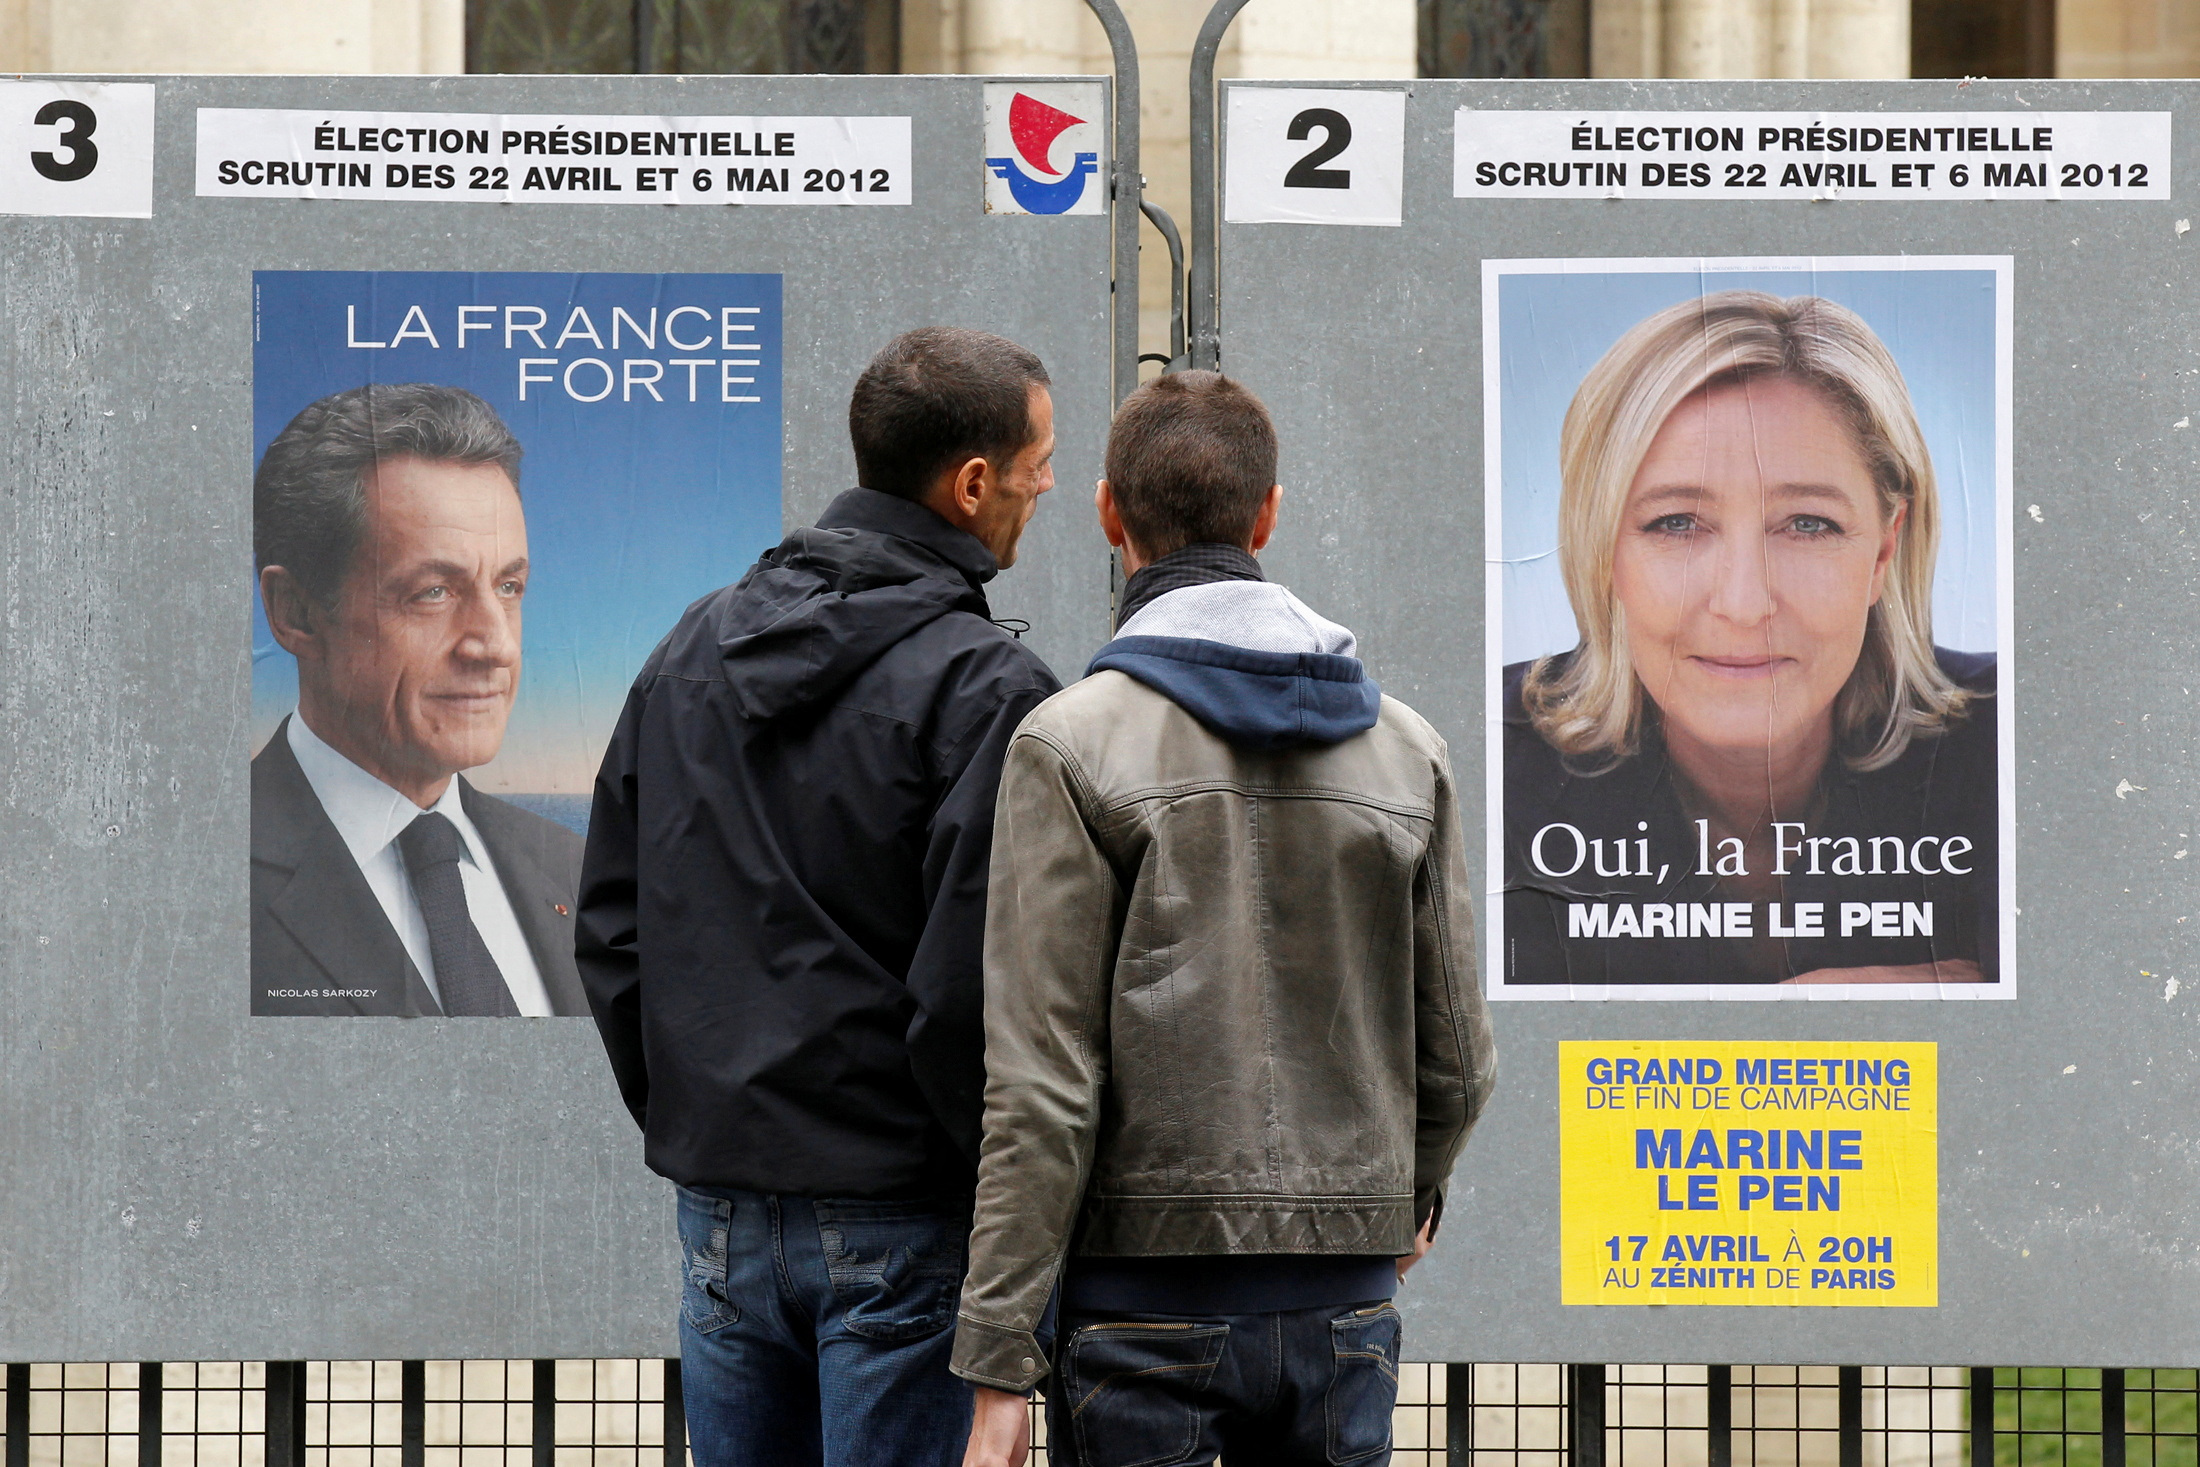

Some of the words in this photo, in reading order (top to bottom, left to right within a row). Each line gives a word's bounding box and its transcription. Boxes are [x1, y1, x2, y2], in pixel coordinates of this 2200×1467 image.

[30, 99, 99, 182] 3
[314, 120, 489, 154] ÉLECTION
[502, 124, 795, 157] PRÉSIDENTIELLE
[1283, 108, 1352, 190] 2
[1571, 120, 1744, 152] ÉLECTION
[1758, 121, 2053, 152] PRÉSIDENTIELLE
[217, 160, 371, 188] SCRUTIN
[386, 164, 456, 190] DES
[468, 166, 509, 190] 22
[521, 166, 622, 191] AVRIL
[636, 167, 679, 192] ET
[692, 168, 713, 192] 6
[727, 167, 789, 192] MAI
[803, 168, 890, 193] 2012
[1475, 161, 1627, 187] SCRUTIN
[1641, 162, 1711, 188] DES
[1724, 163, 1767, 187] 22
[1779, 163, 1877, 188] AVRIL
[1891, 163, 1936, 188] ET
[1949, 163, 1969, 188] 6
[1983, 163, 2047, 187] MAI
[2060, 163, 2149, 188] 2012
[347, 304, 440, 349] LA
[458, 305, 761, 351] FRANCE
[519, 357, 761, 403] FORTE
[1531, 821, 1670, 885] Oui,
[1694, 818, 1750, 876] la
[1770, 822, 1973, 876] France
[1568, 902, 1753, 938] MARINE
[1769, 902, 1825, 938] LE
[1840, 901, 1933, 937] PEN
[267, 989, 319, 998] NICOLAS
[322, 988, 378, 998] SARKOZY
[1586, 1057, 1723, 1086] GRAND
[1735, 1058, 1911, 1087] MEETING
[1586, 1086, 1626, 1110] DE
[1636, 1086, 1681, 1110] FIN
[1692, 1086, 1731, 1110] DE
[1740, 1086, 1911, 1111] CAMPAGNE
[1635, 1128, 1863, 1171] MARINE
[1658, 1174, 1719, 1211] LE
[1738, 1175, 1840, 1212] PEN
[1605, 1235, 1649, 1262] 17
[1661, 1234, 1770, 1263] AVRIL
[1782, 1228, 1806, 1263] À
[1818, 1236, 1892, 1264] 20H
[1603, 1267, 1640, 1289] AU
[1650, 1262, 1755, 1289] ZÉNITH
[1766, 1268, 1800, 1289] DE
[1811, 1268, 1896, 1290] PARIS
